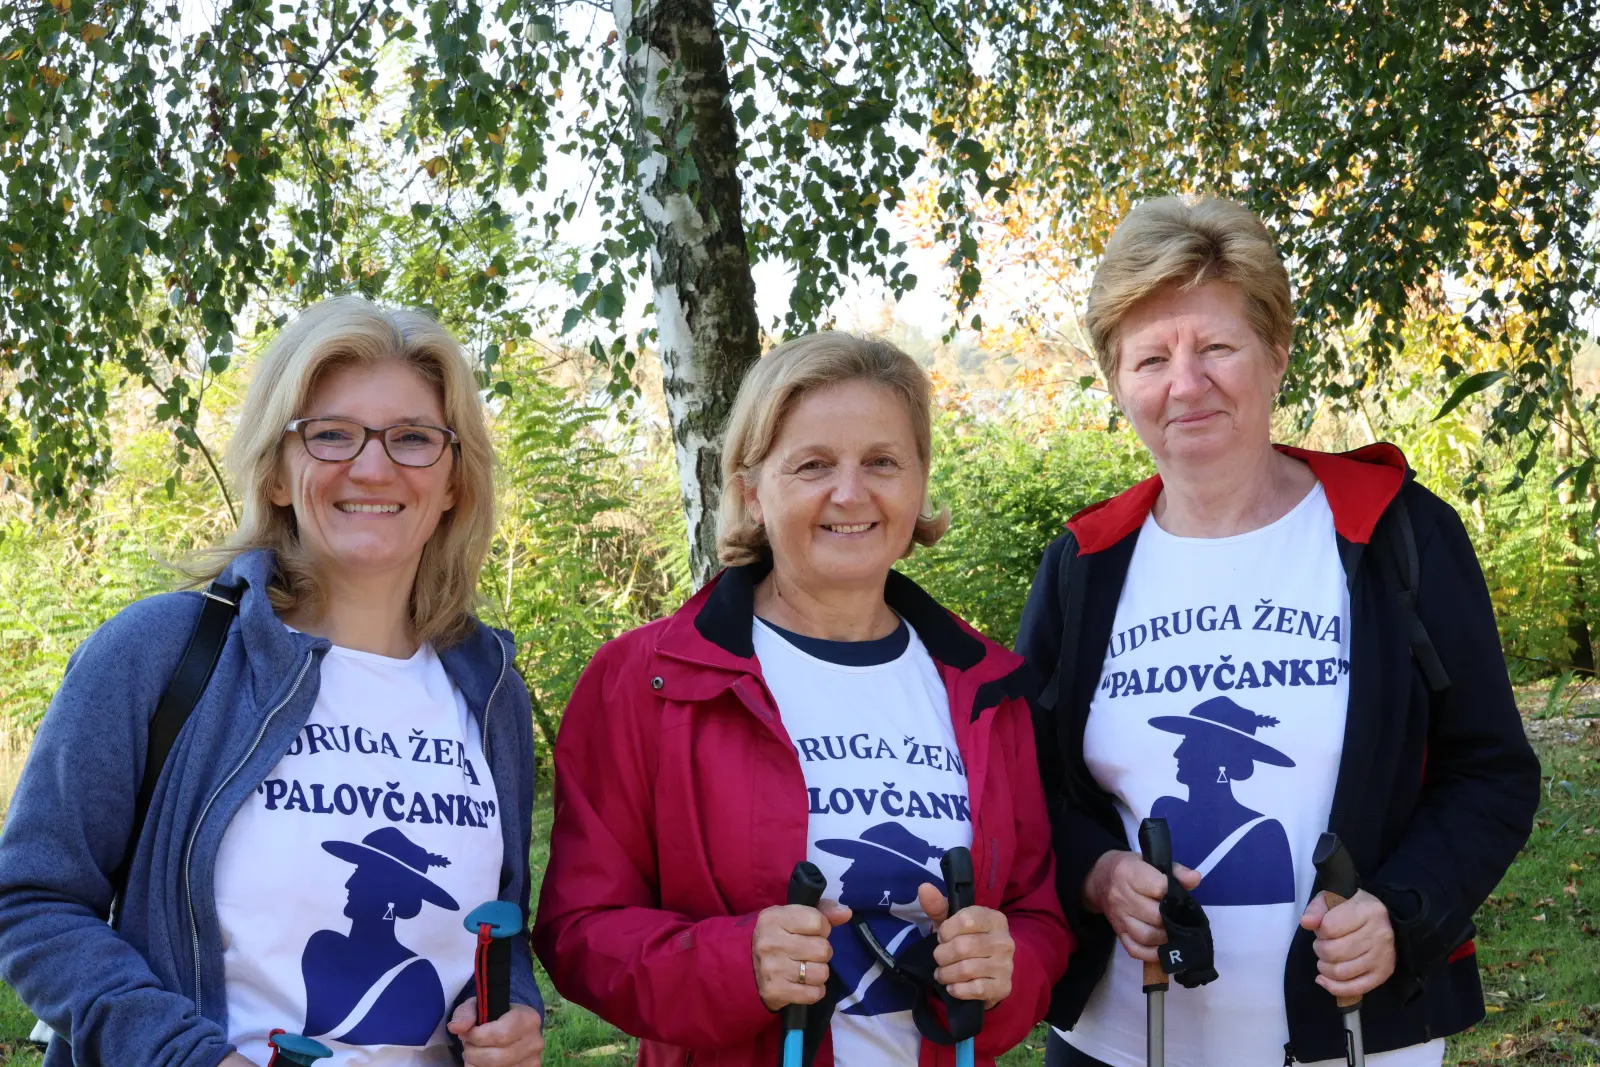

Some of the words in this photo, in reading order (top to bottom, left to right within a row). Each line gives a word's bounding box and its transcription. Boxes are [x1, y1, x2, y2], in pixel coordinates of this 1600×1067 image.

[1109, 605, 1242, 659] UDRUGA
[1252, 598, 1341, 644] ŽENA
[794, 733, 899, 761] RUGA
[903, 735, 967, 778] ŽEN
[1169, 949, 1183, 964] R
